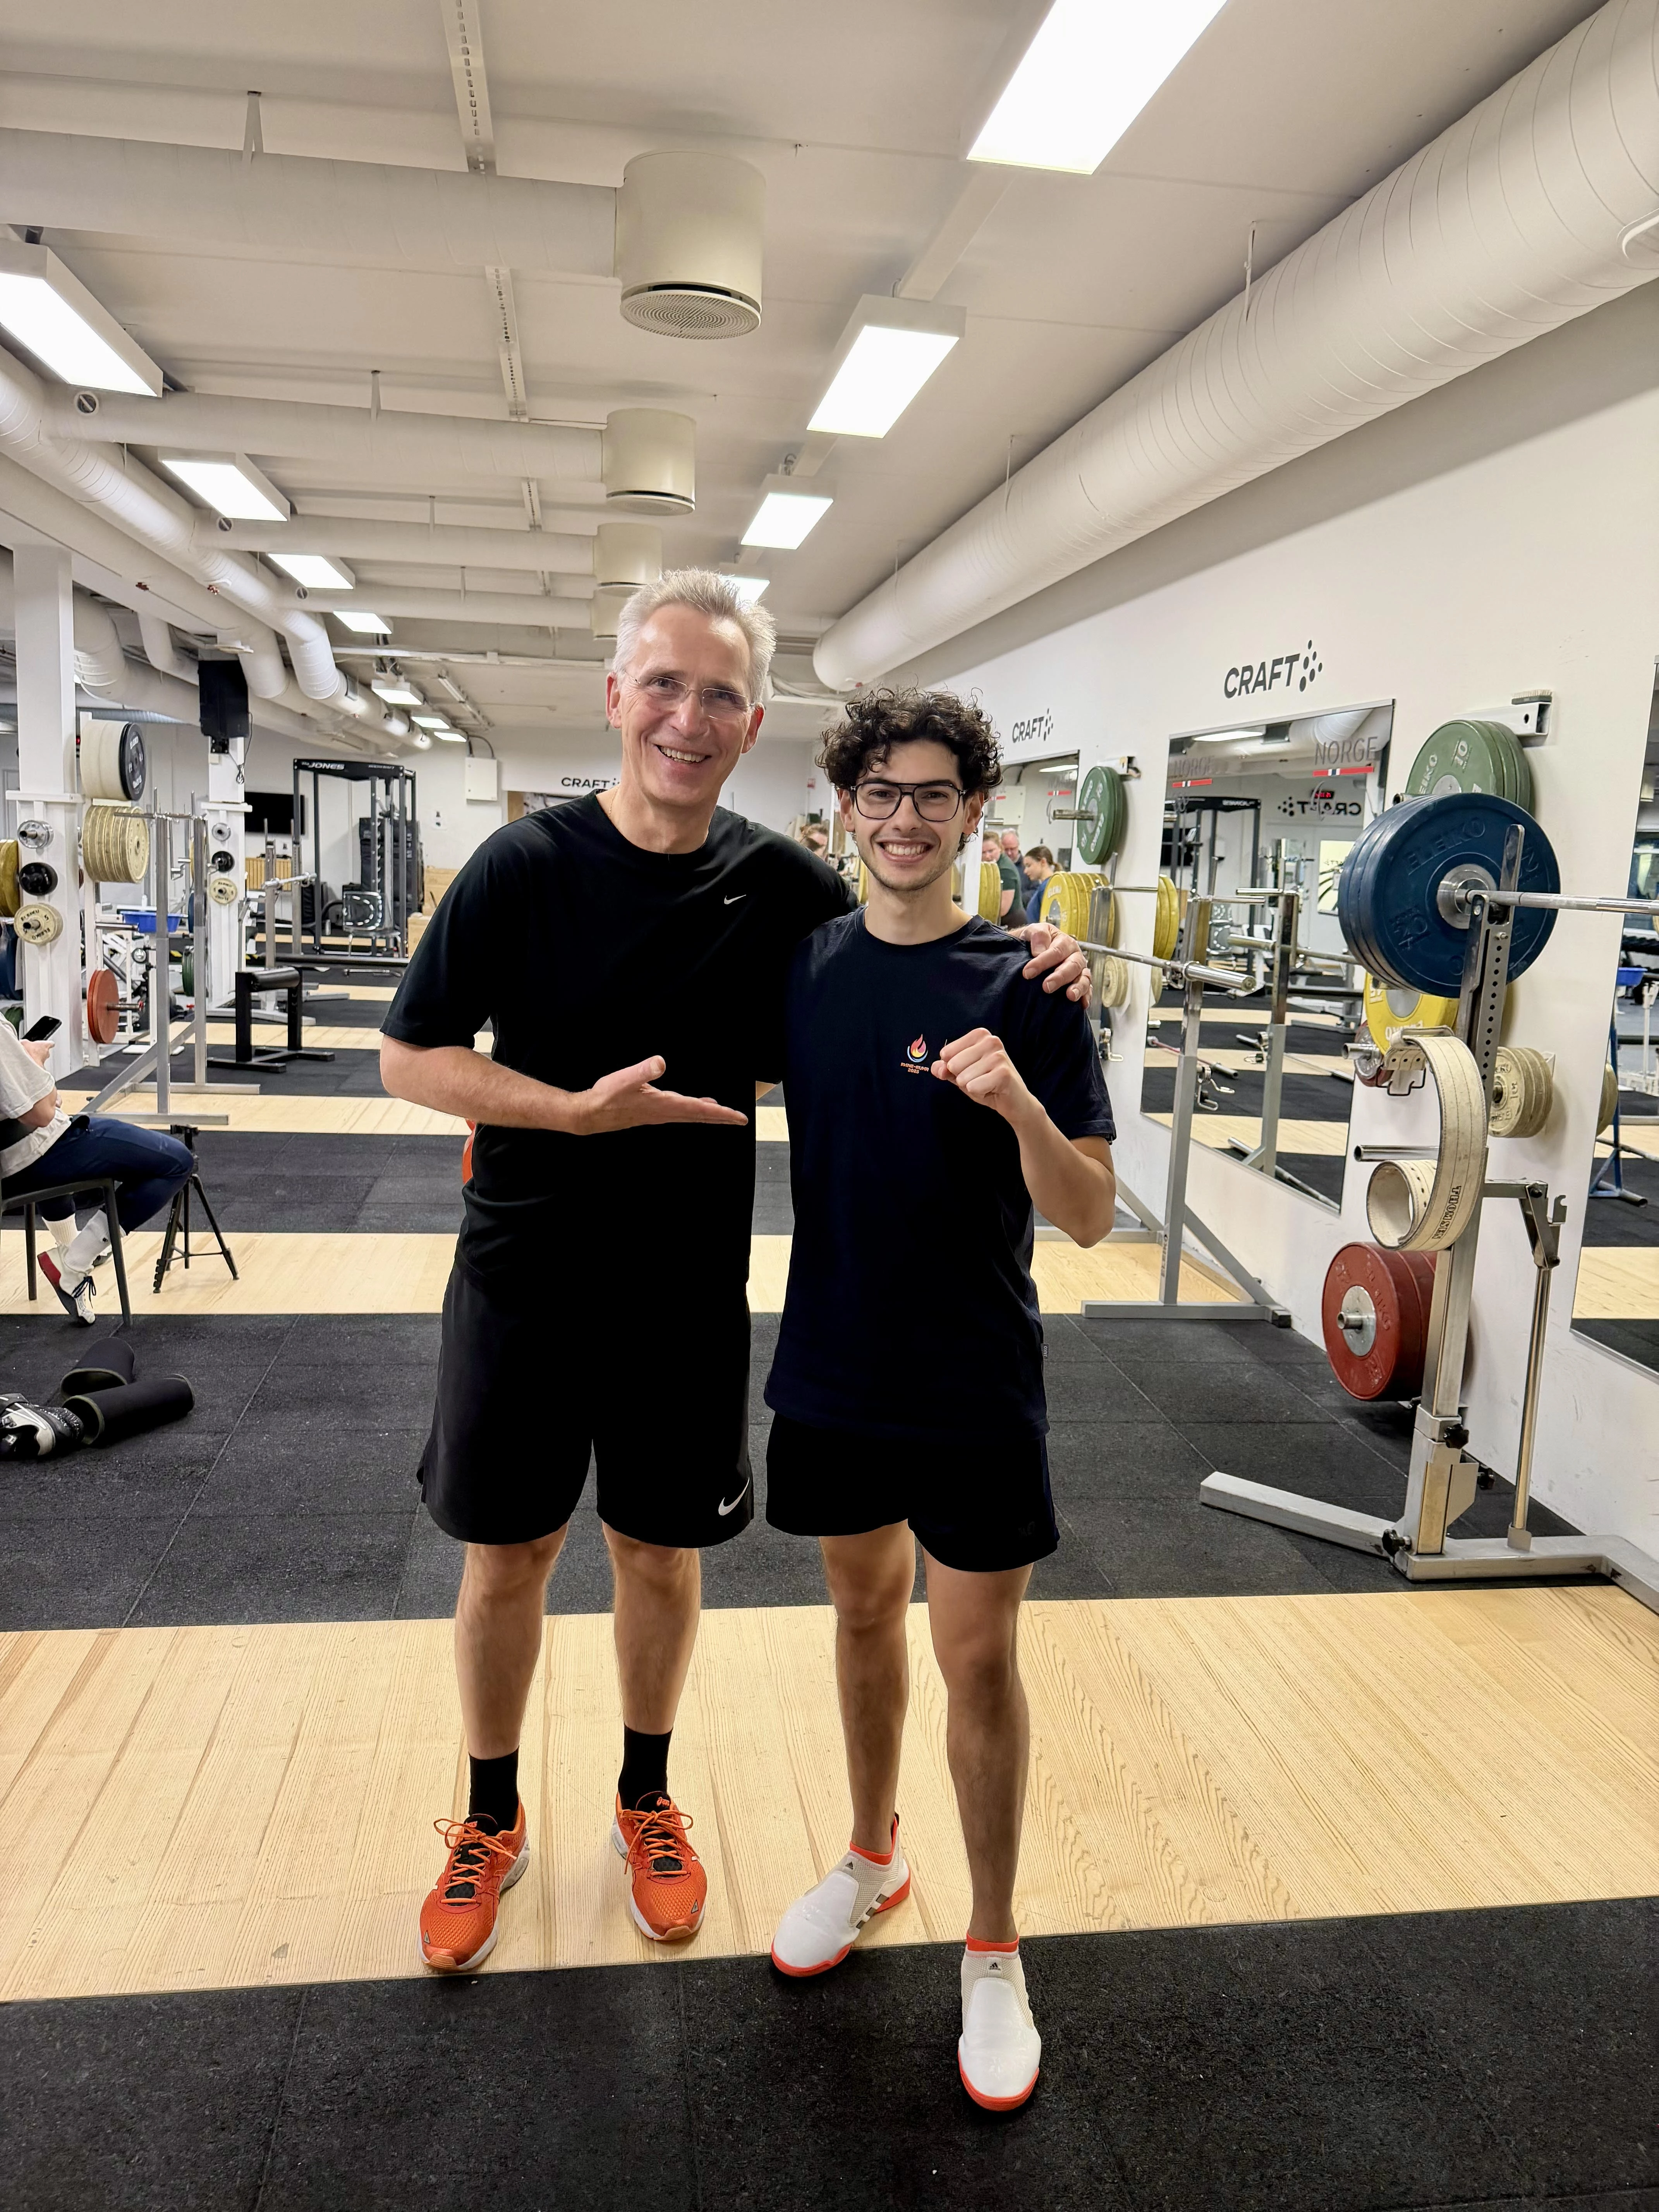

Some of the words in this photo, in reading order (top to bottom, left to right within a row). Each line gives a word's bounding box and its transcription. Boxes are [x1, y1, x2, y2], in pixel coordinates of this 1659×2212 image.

[1224, 653, 1300, 699] CRAFT
[1012, 716, 1044, 744] CRAFT
[1314, 737, 1378, 765] NORGE
[308, 762, 345, 770] JONES
[1419, 755, 1437, 794] EIKO
[562, 777, 610, 788] CRAFT
[1432, 1186, 1462, 1239] THOMSEN
